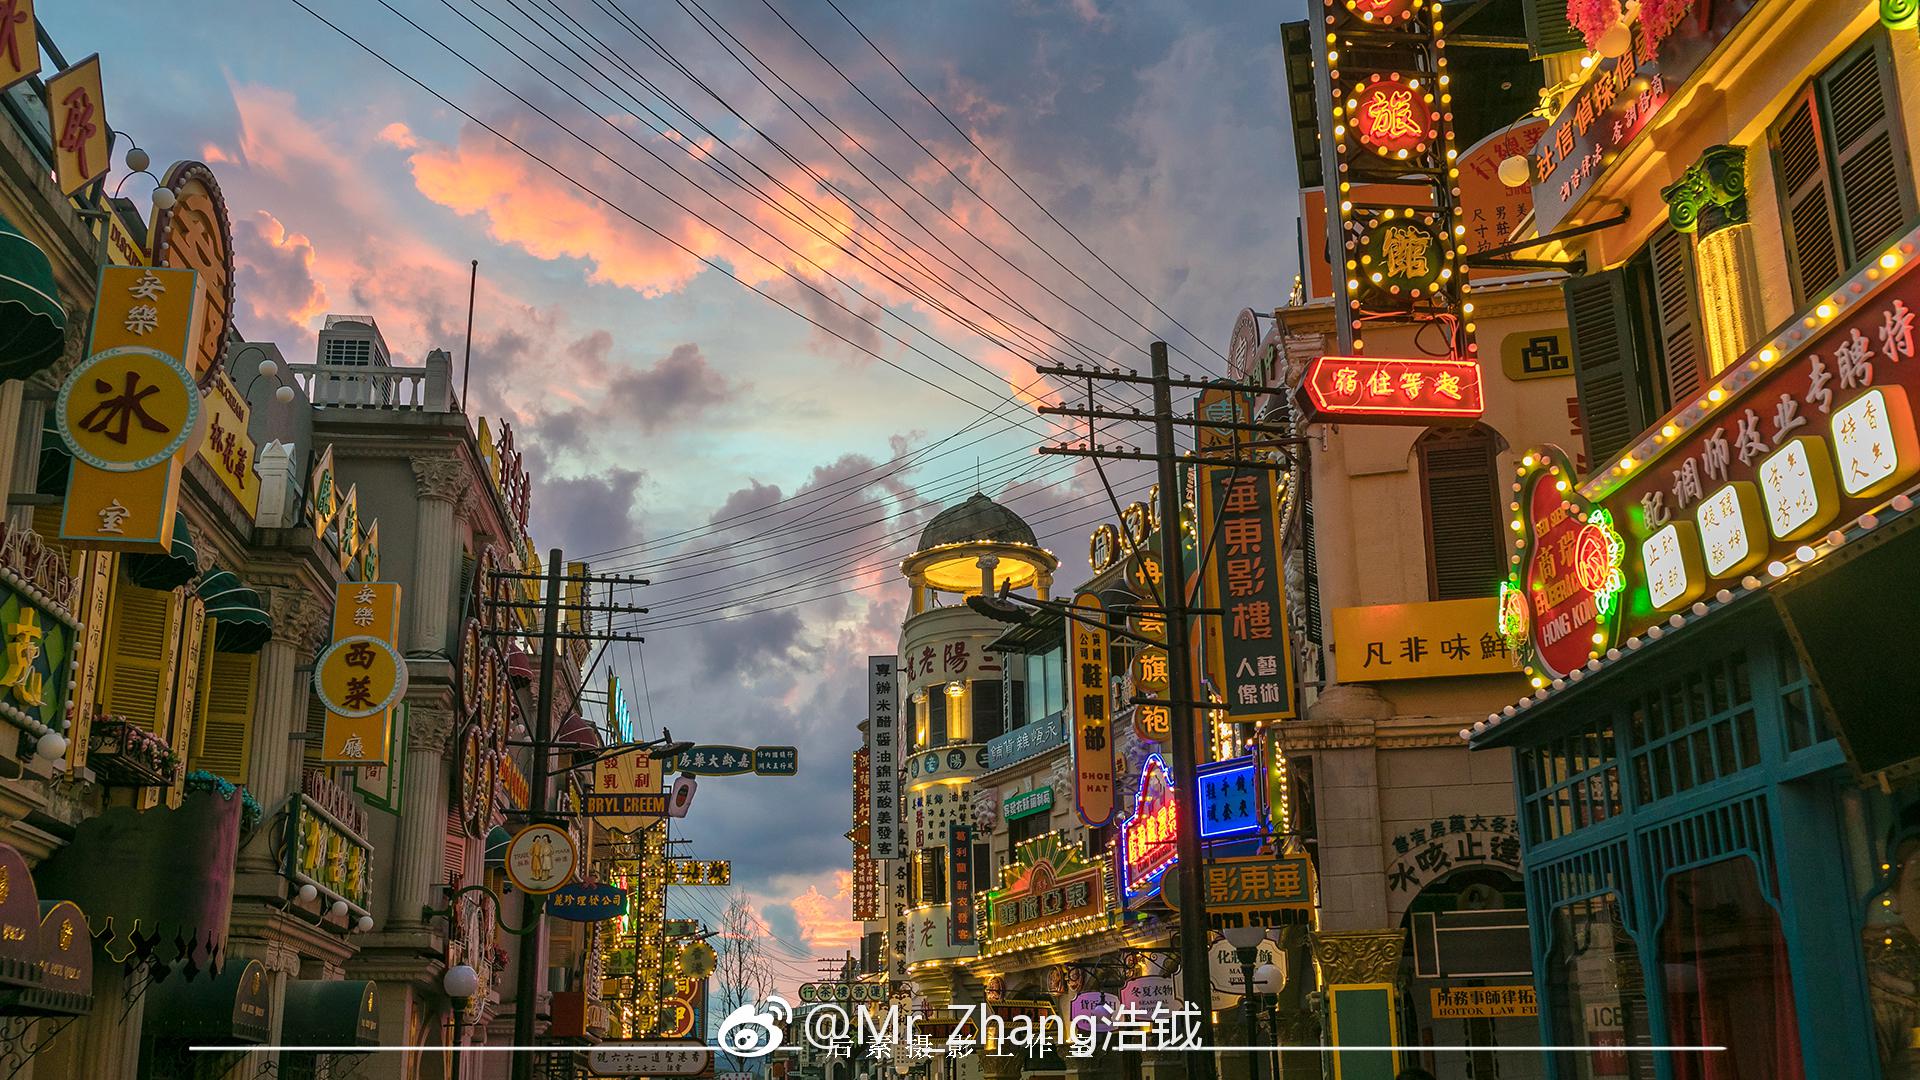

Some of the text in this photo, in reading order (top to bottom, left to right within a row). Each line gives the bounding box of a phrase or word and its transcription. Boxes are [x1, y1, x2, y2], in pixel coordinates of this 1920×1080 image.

[1221, 475, 1272, 641] 華東影樓
[1542, 595, 1598, 648] HONG KON
[1082, 772, 1110, 781] SHOE
[1087, 784, 1109, 793] HAT
[587, 797, 665, 814] BRYL CREEM
[1490, 1007, 1515, 1015] LAW
